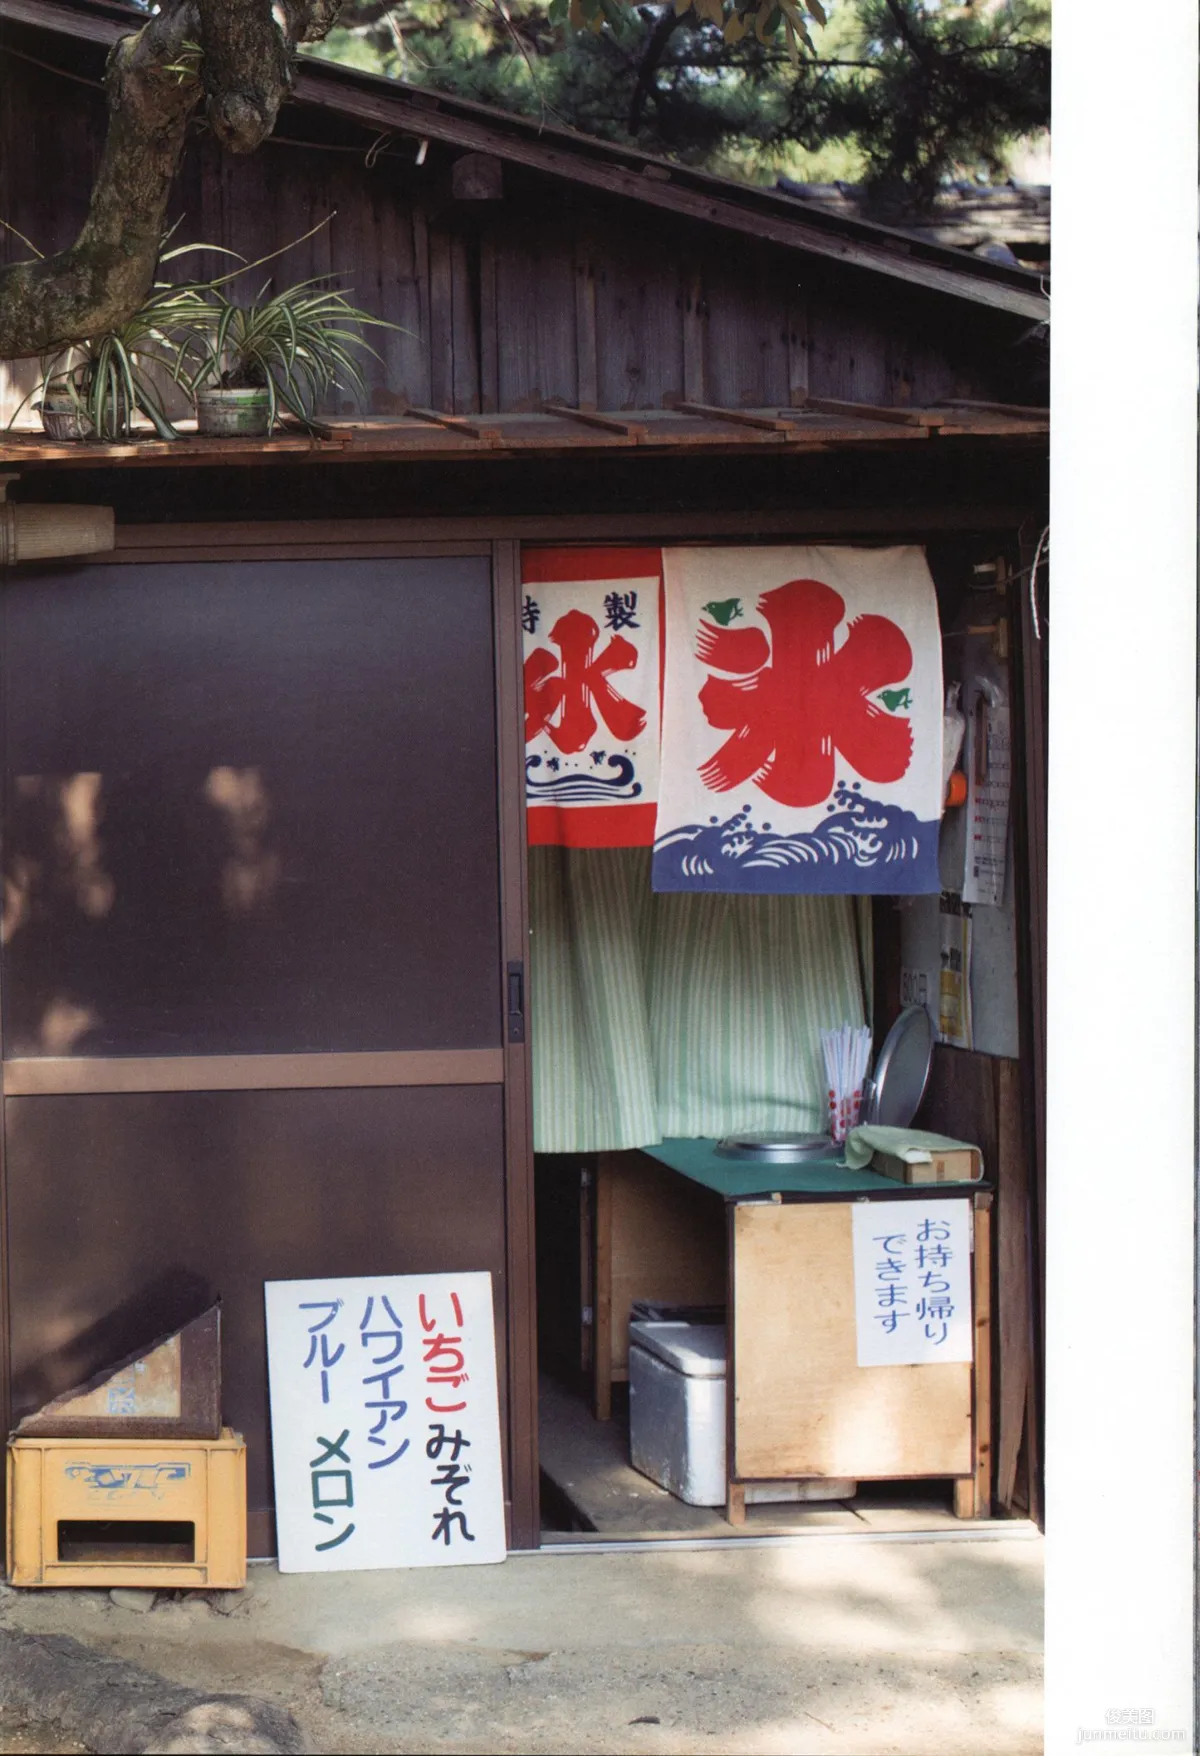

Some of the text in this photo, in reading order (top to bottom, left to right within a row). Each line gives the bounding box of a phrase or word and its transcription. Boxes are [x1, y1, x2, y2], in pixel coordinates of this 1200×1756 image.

[603, 591, 640, 631] 製
[694, 578, 915, 809] 氷
[872, 1233, 911, 1334] できます
[914, 1218, 955, 1345] お持ち帰り
[299, 1297, 355, 1552] ブルー メロン
[359, 1295, 410, 1470] ハワイアン
[418, 1292, 475, 1546] いちご みぞれ
